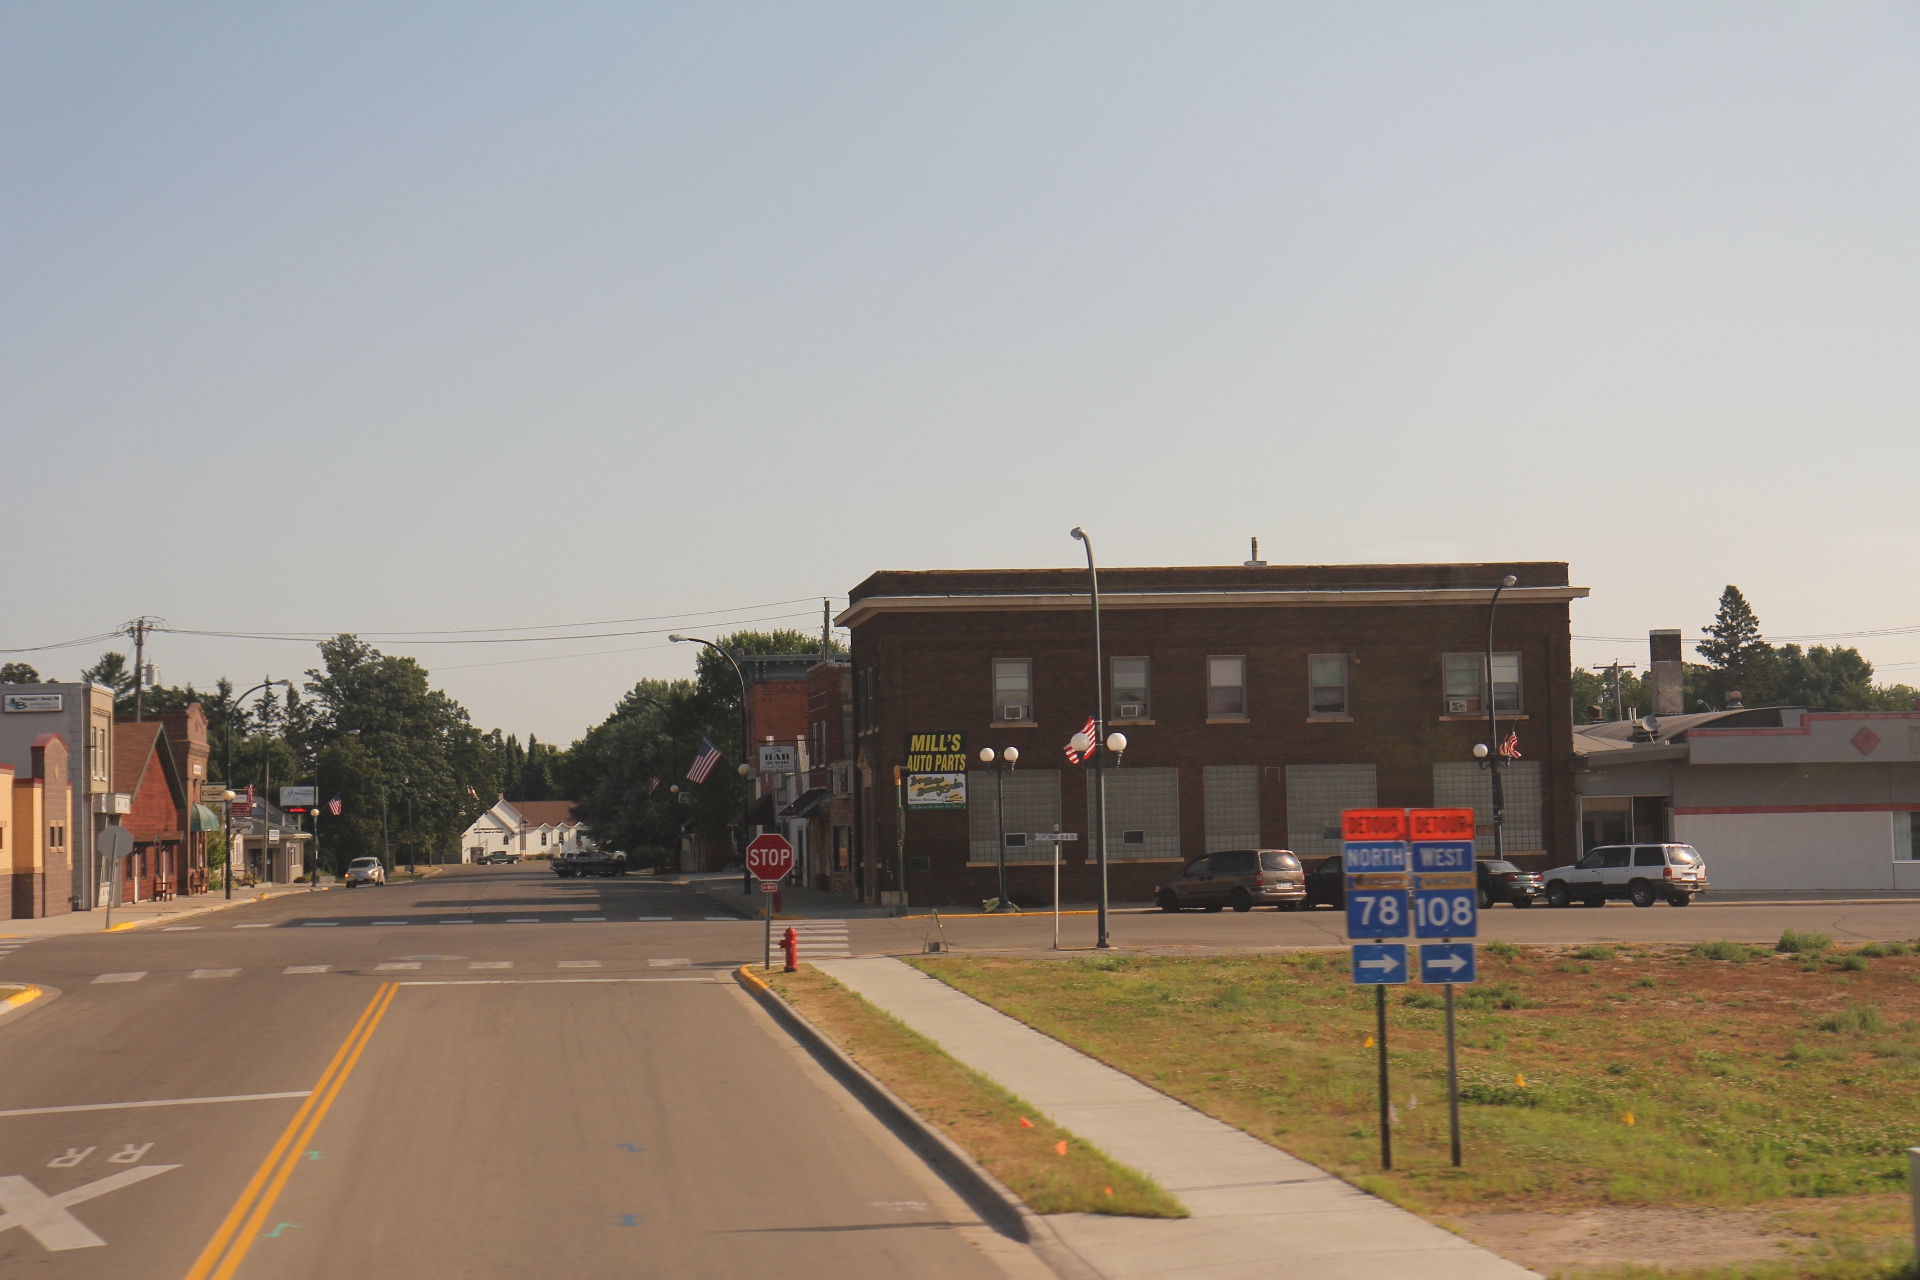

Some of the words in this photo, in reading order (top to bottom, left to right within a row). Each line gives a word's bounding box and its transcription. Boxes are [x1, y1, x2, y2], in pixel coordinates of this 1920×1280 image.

[911, 734, 961, 751] MILL'S
[907, 754, 932, 772] AUTO
[935, 753, 966, 771] PARTS
[750, 848, 790, 866] STOP
[1346, 848, 1404, 867] NORTH
[1419, 847, 1464, 867] WEST
[1355, 896, 1400, 925] 78
[1415, 896, 1473, 926] 108
